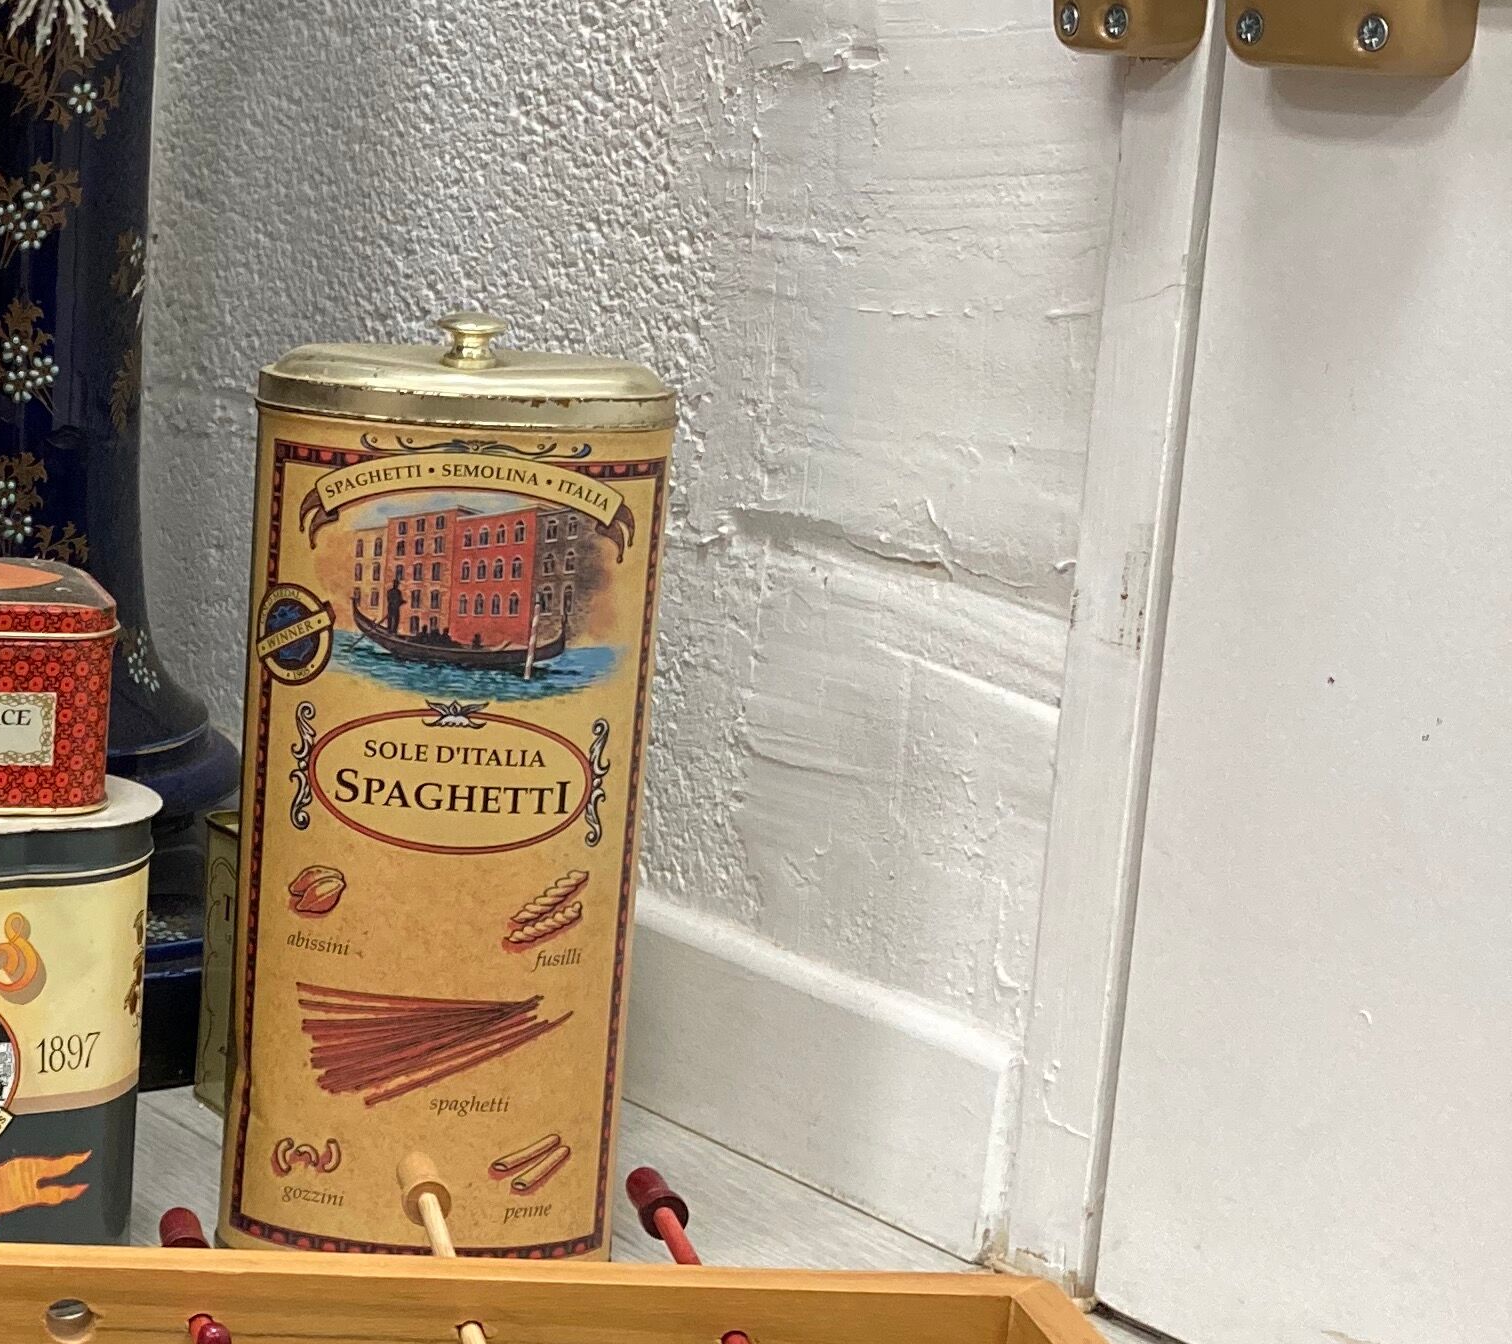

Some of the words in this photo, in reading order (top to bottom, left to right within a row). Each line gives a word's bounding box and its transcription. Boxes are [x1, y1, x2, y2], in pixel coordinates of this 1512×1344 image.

[324, 464, 422, 499] SPAGHETTI
[441, 463, 539, 486] SEMOLINA
[558, 479, 611, 512] ITALIA
[267, 620, 314, 649] WINNER
[363, 739, 429, 763] SOLE
[436, 744, 546, 768] D'ITALIA
[334, 767, 571, 815] SPAGHETTI
[286, 931, 351, 956] abissini
[531, 948, 582, 973] fusilli
[36, 1032, 101, 1074] 1897
[428, 1094, 510, 1117] spaghetti
[281, 1184, 345, 1207] gozzini
[502, 1201, 553, 1224] penne
